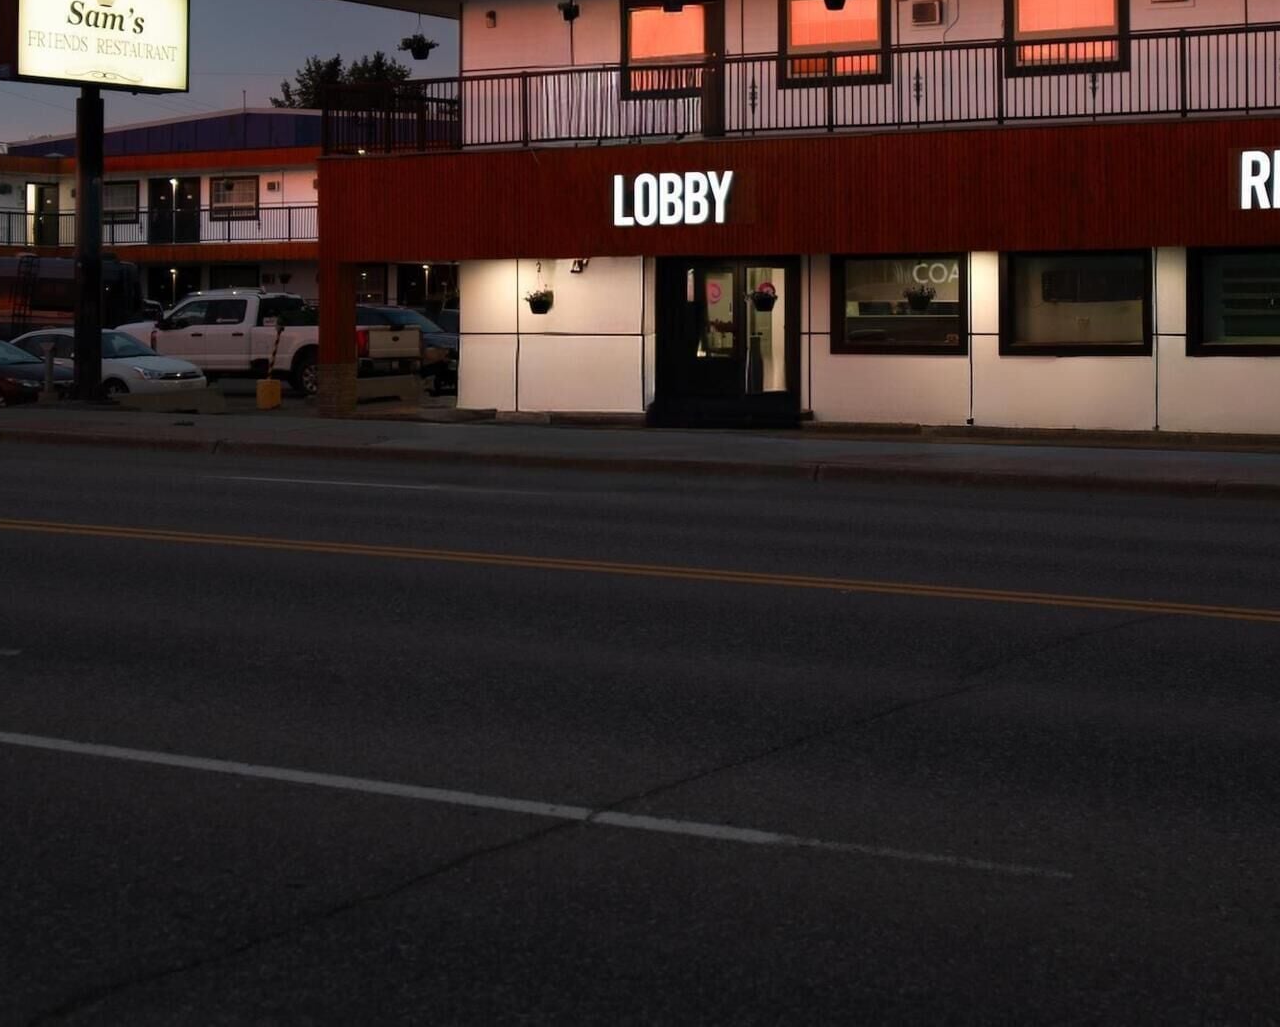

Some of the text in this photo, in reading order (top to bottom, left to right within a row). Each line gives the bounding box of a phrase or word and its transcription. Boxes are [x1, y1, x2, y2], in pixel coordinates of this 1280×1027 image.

[67, 0, 145, 34] Sam's
[28, 30, 178, 63] FRIENDS RESTAURANT
[613, 170, 733, 227] LOBBY
